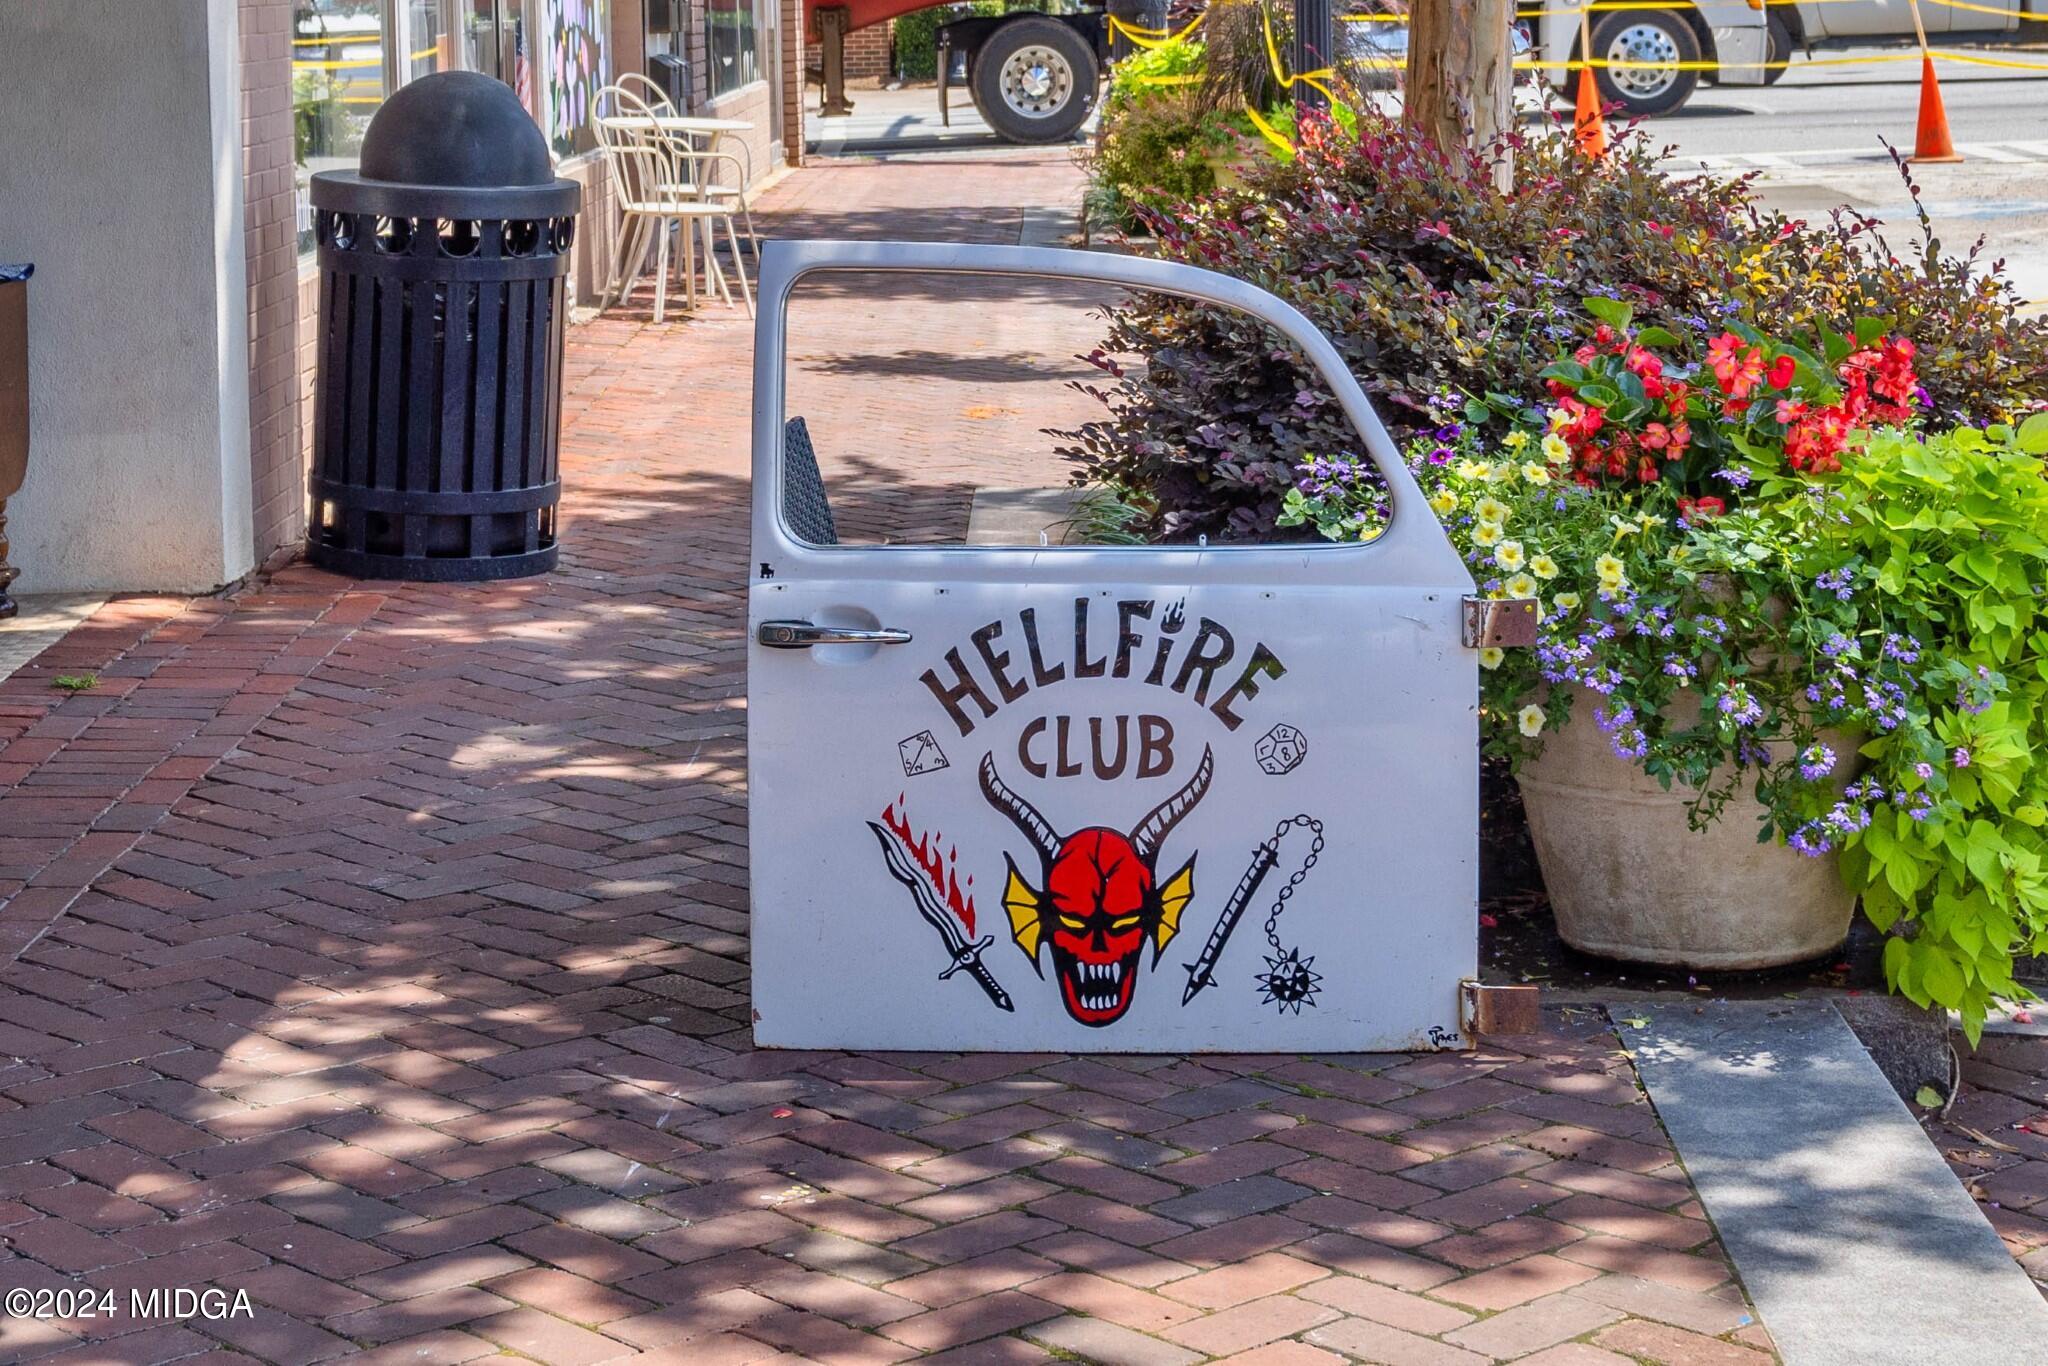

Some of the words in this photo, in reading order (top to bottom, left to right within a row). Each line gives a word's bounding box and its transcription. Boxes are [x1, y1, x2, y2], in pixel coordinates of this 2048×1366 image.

[1276, 728, 1290, 740] 12
[925, 740, 934, 751] 4
[1018, 715, 1174, 780] CLUB
[1281, 746, 1292, 762] 8
[1266, 762, 1276, 774] 3
